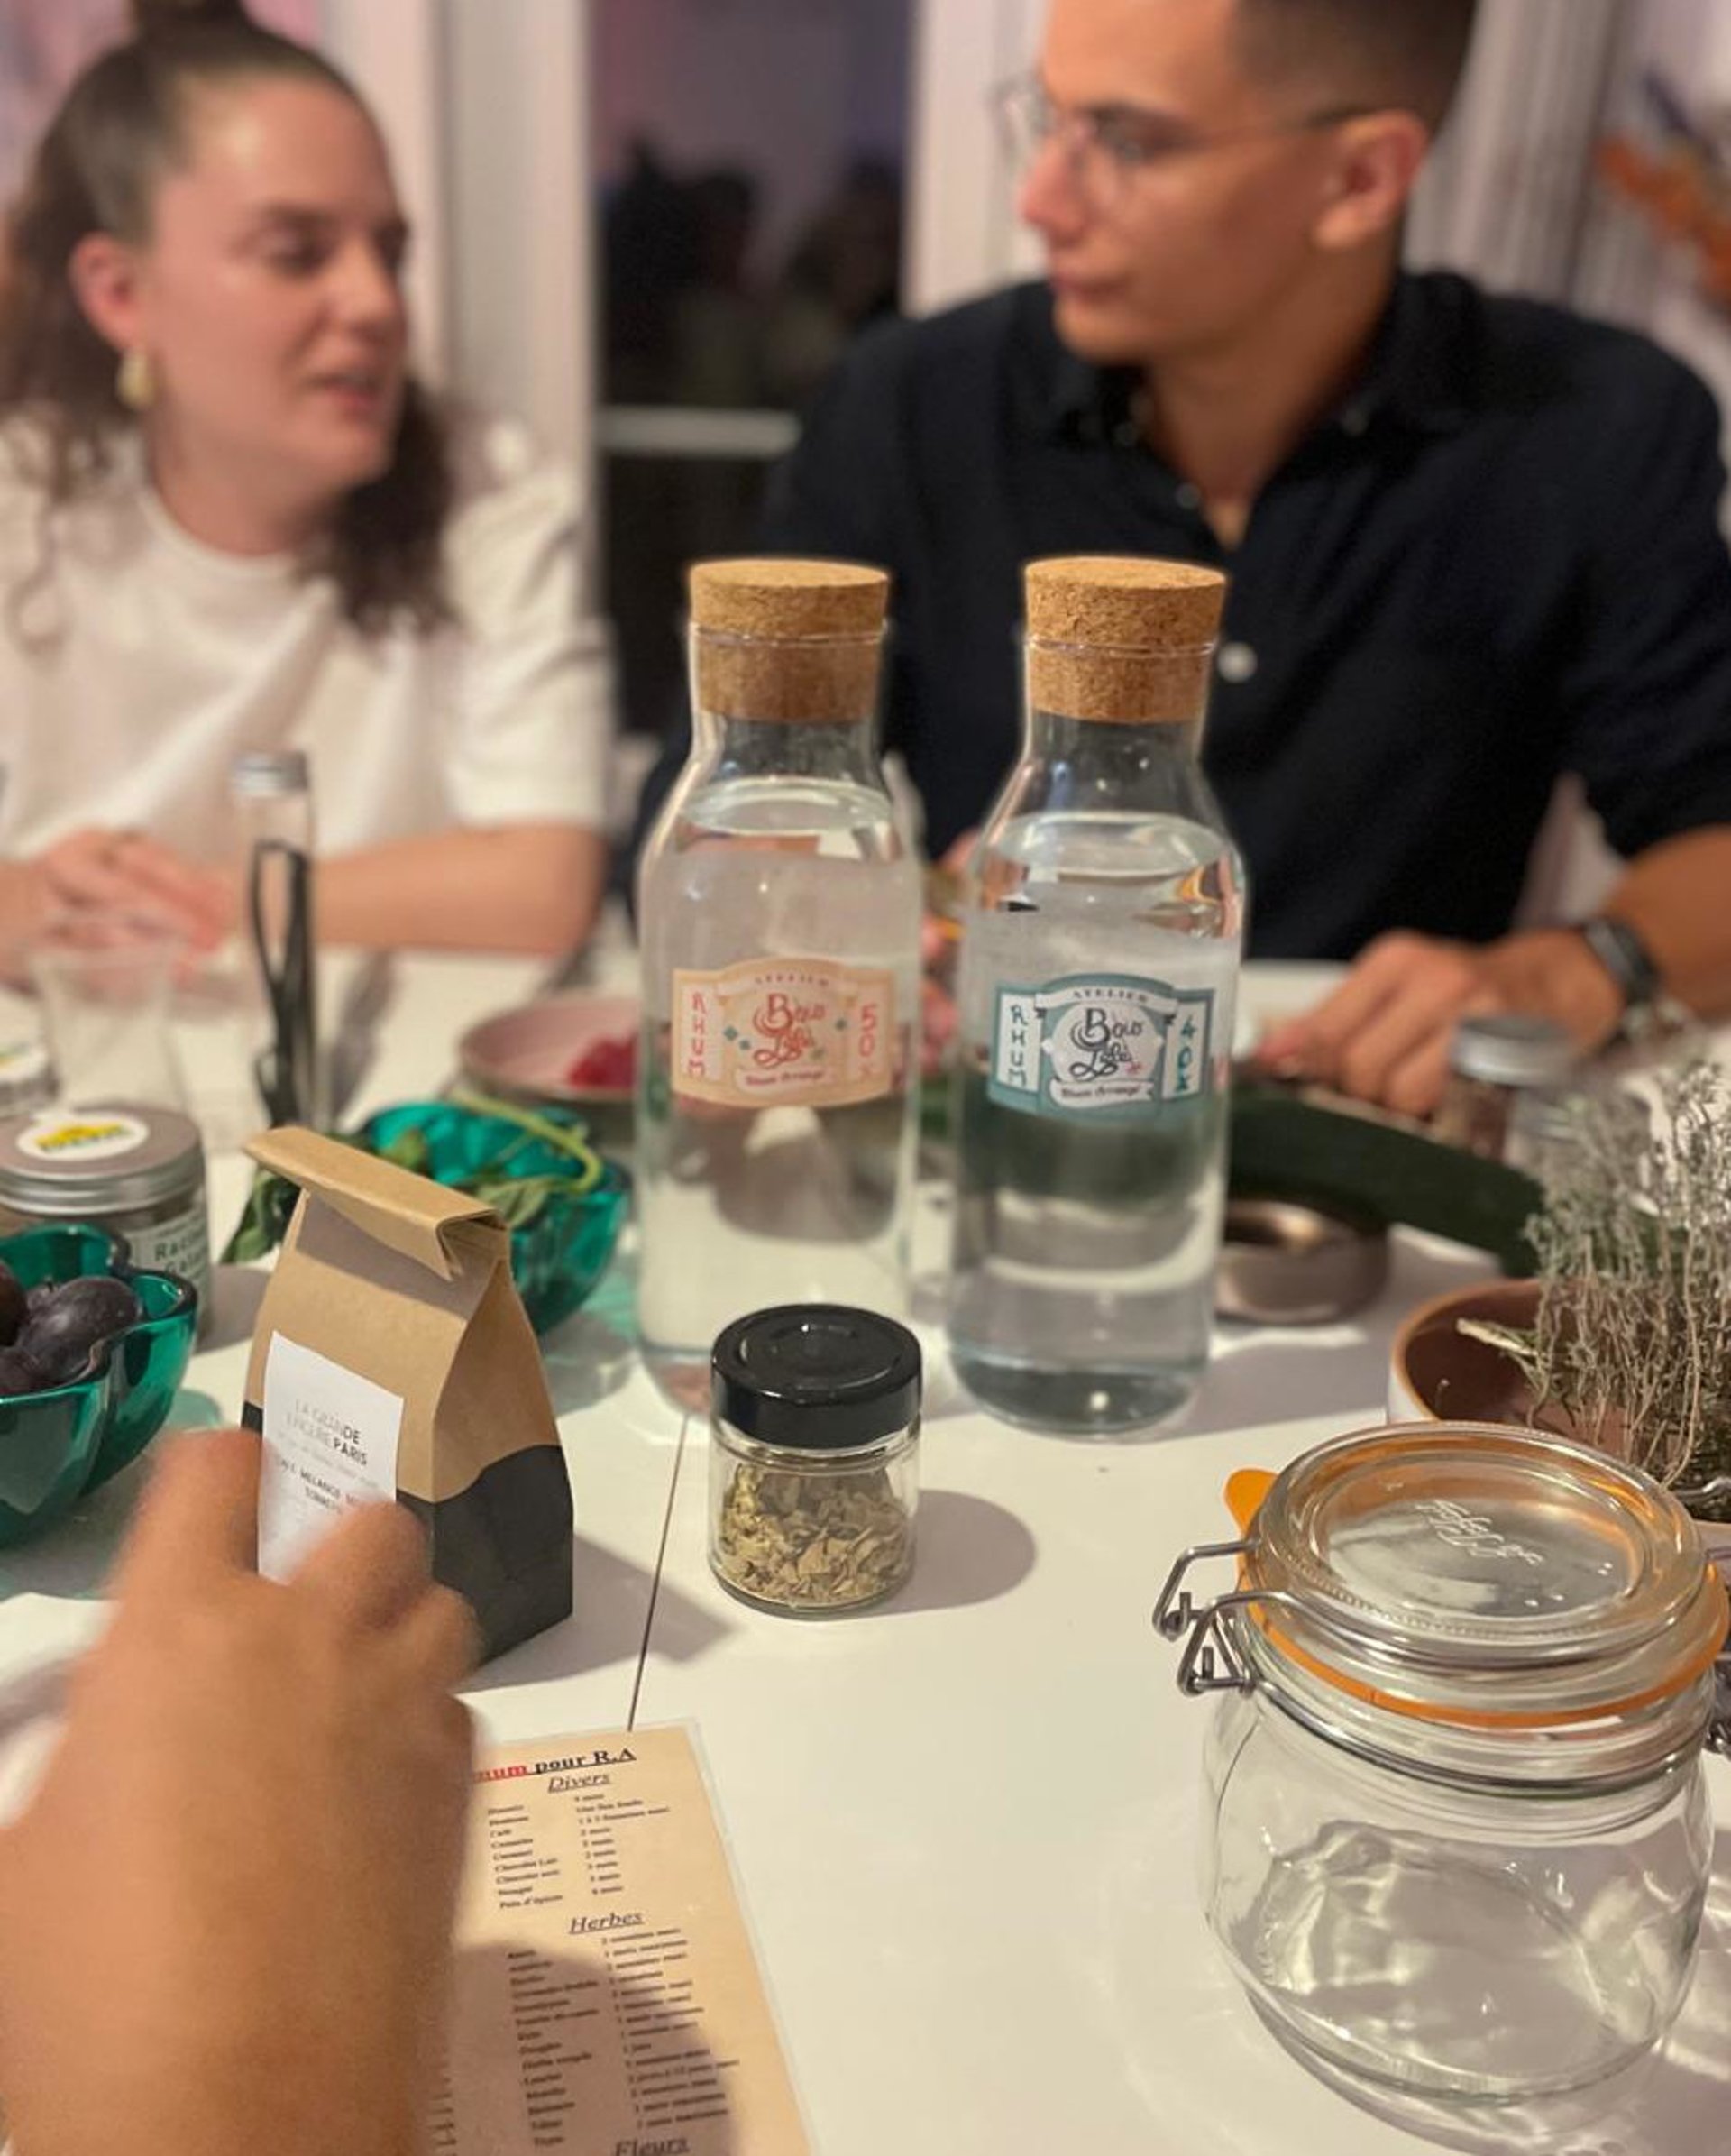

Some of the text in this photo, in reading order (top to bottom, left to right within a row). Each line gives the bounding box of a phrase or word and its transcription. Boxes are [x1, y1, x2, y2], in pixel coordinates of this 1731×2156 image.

[1008, 1005, 1028, 1087] RHUM
[334, 1436, 368, 1467] PARIS
[535, 1756, 587, 1775] pour
[592, 1748, 637, 1764] R.A
[547, 1773, 611, 1793] Divers
[569, 1912, 645, 1934] Herbes
